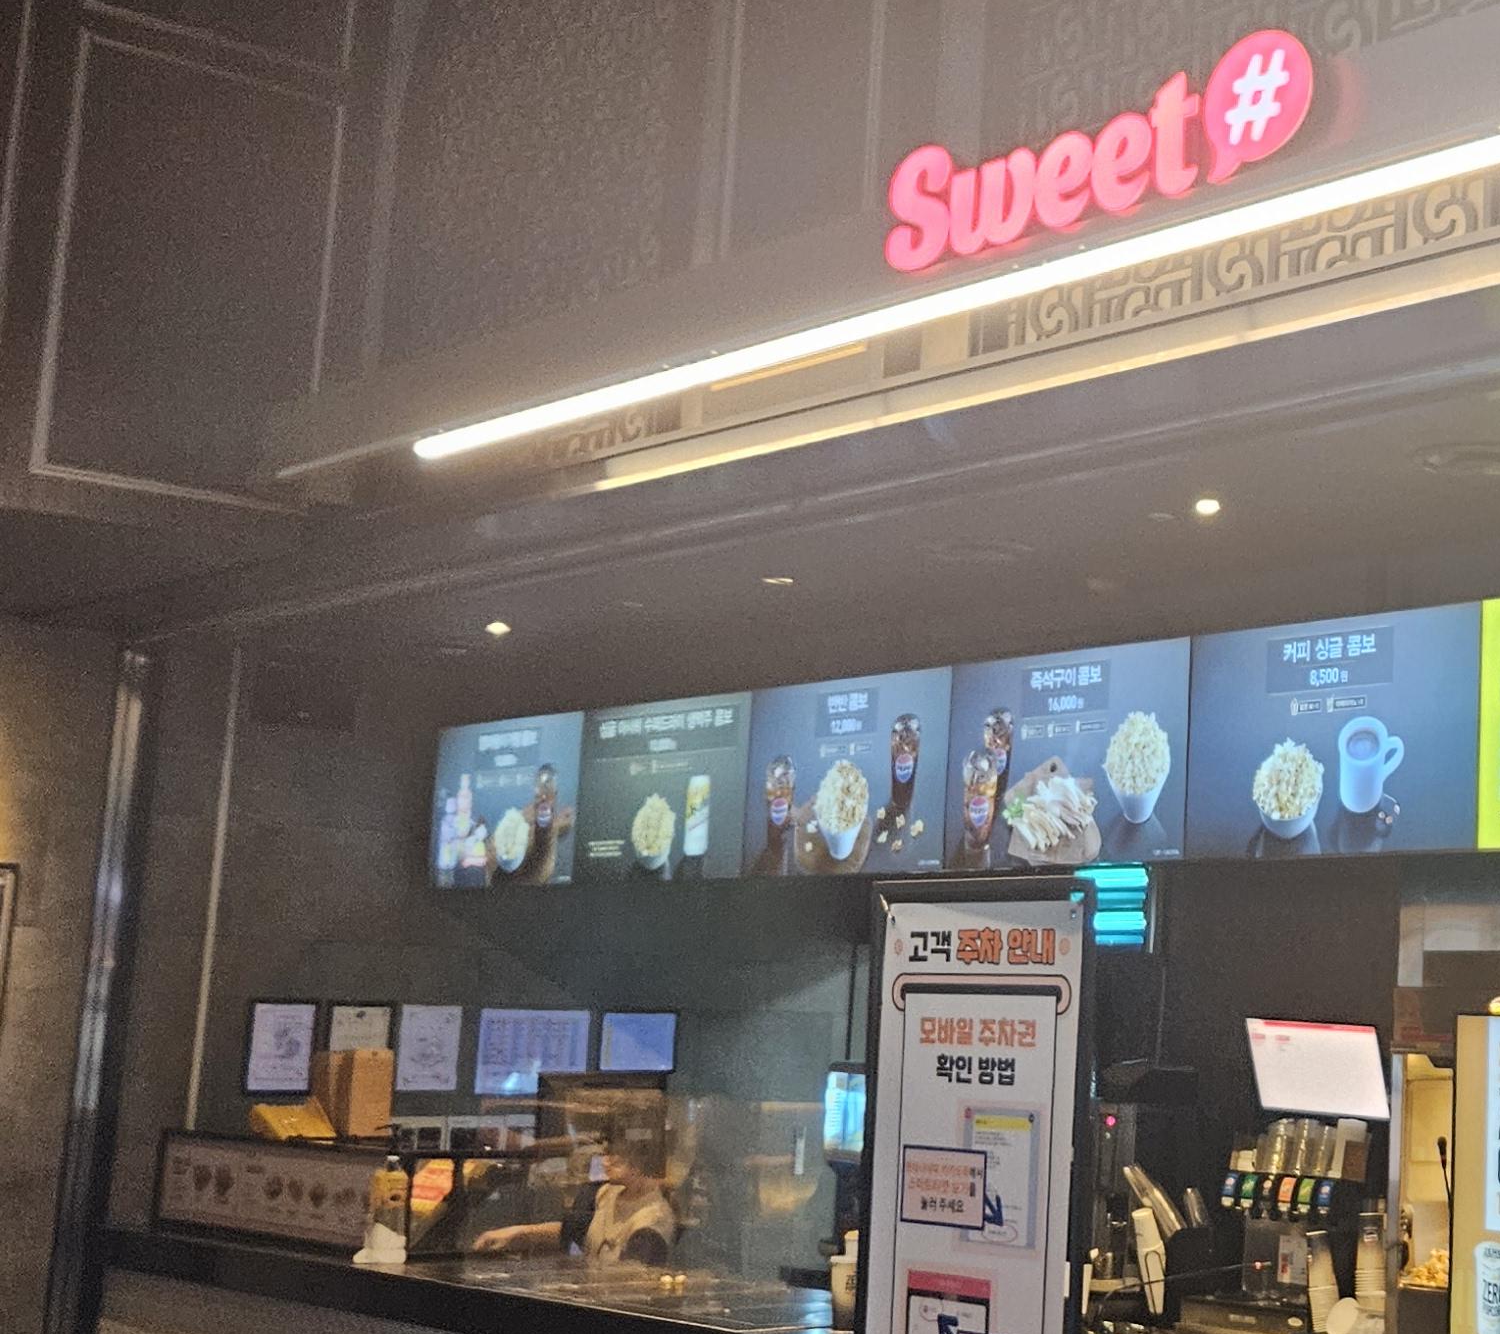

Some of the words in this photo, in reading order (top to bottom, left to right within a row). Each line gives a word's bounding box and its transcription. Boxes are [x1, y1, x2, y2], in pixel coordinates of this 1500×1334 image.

[885, 71, 1201, 272] Sweet
[1283, 639, 1311, 663] 커피
[1315, 636, 1344, 660] 싱글
[1347, 633, 1377, 657] 콤보
[1030, 666, 1077, 691] 즉석구이
[908, 930, 952, 963] 고객
[956, 927, 1003, 965] 주차
[1007, 927, 1056, 965] 안내
[919, 1017, 973, 1046] 모바일
[978, 1018, 1036, 1047] 주차권
[936, 1053, 973, 1084] 확인
[977, 1056, 1016, 1086] 방법
